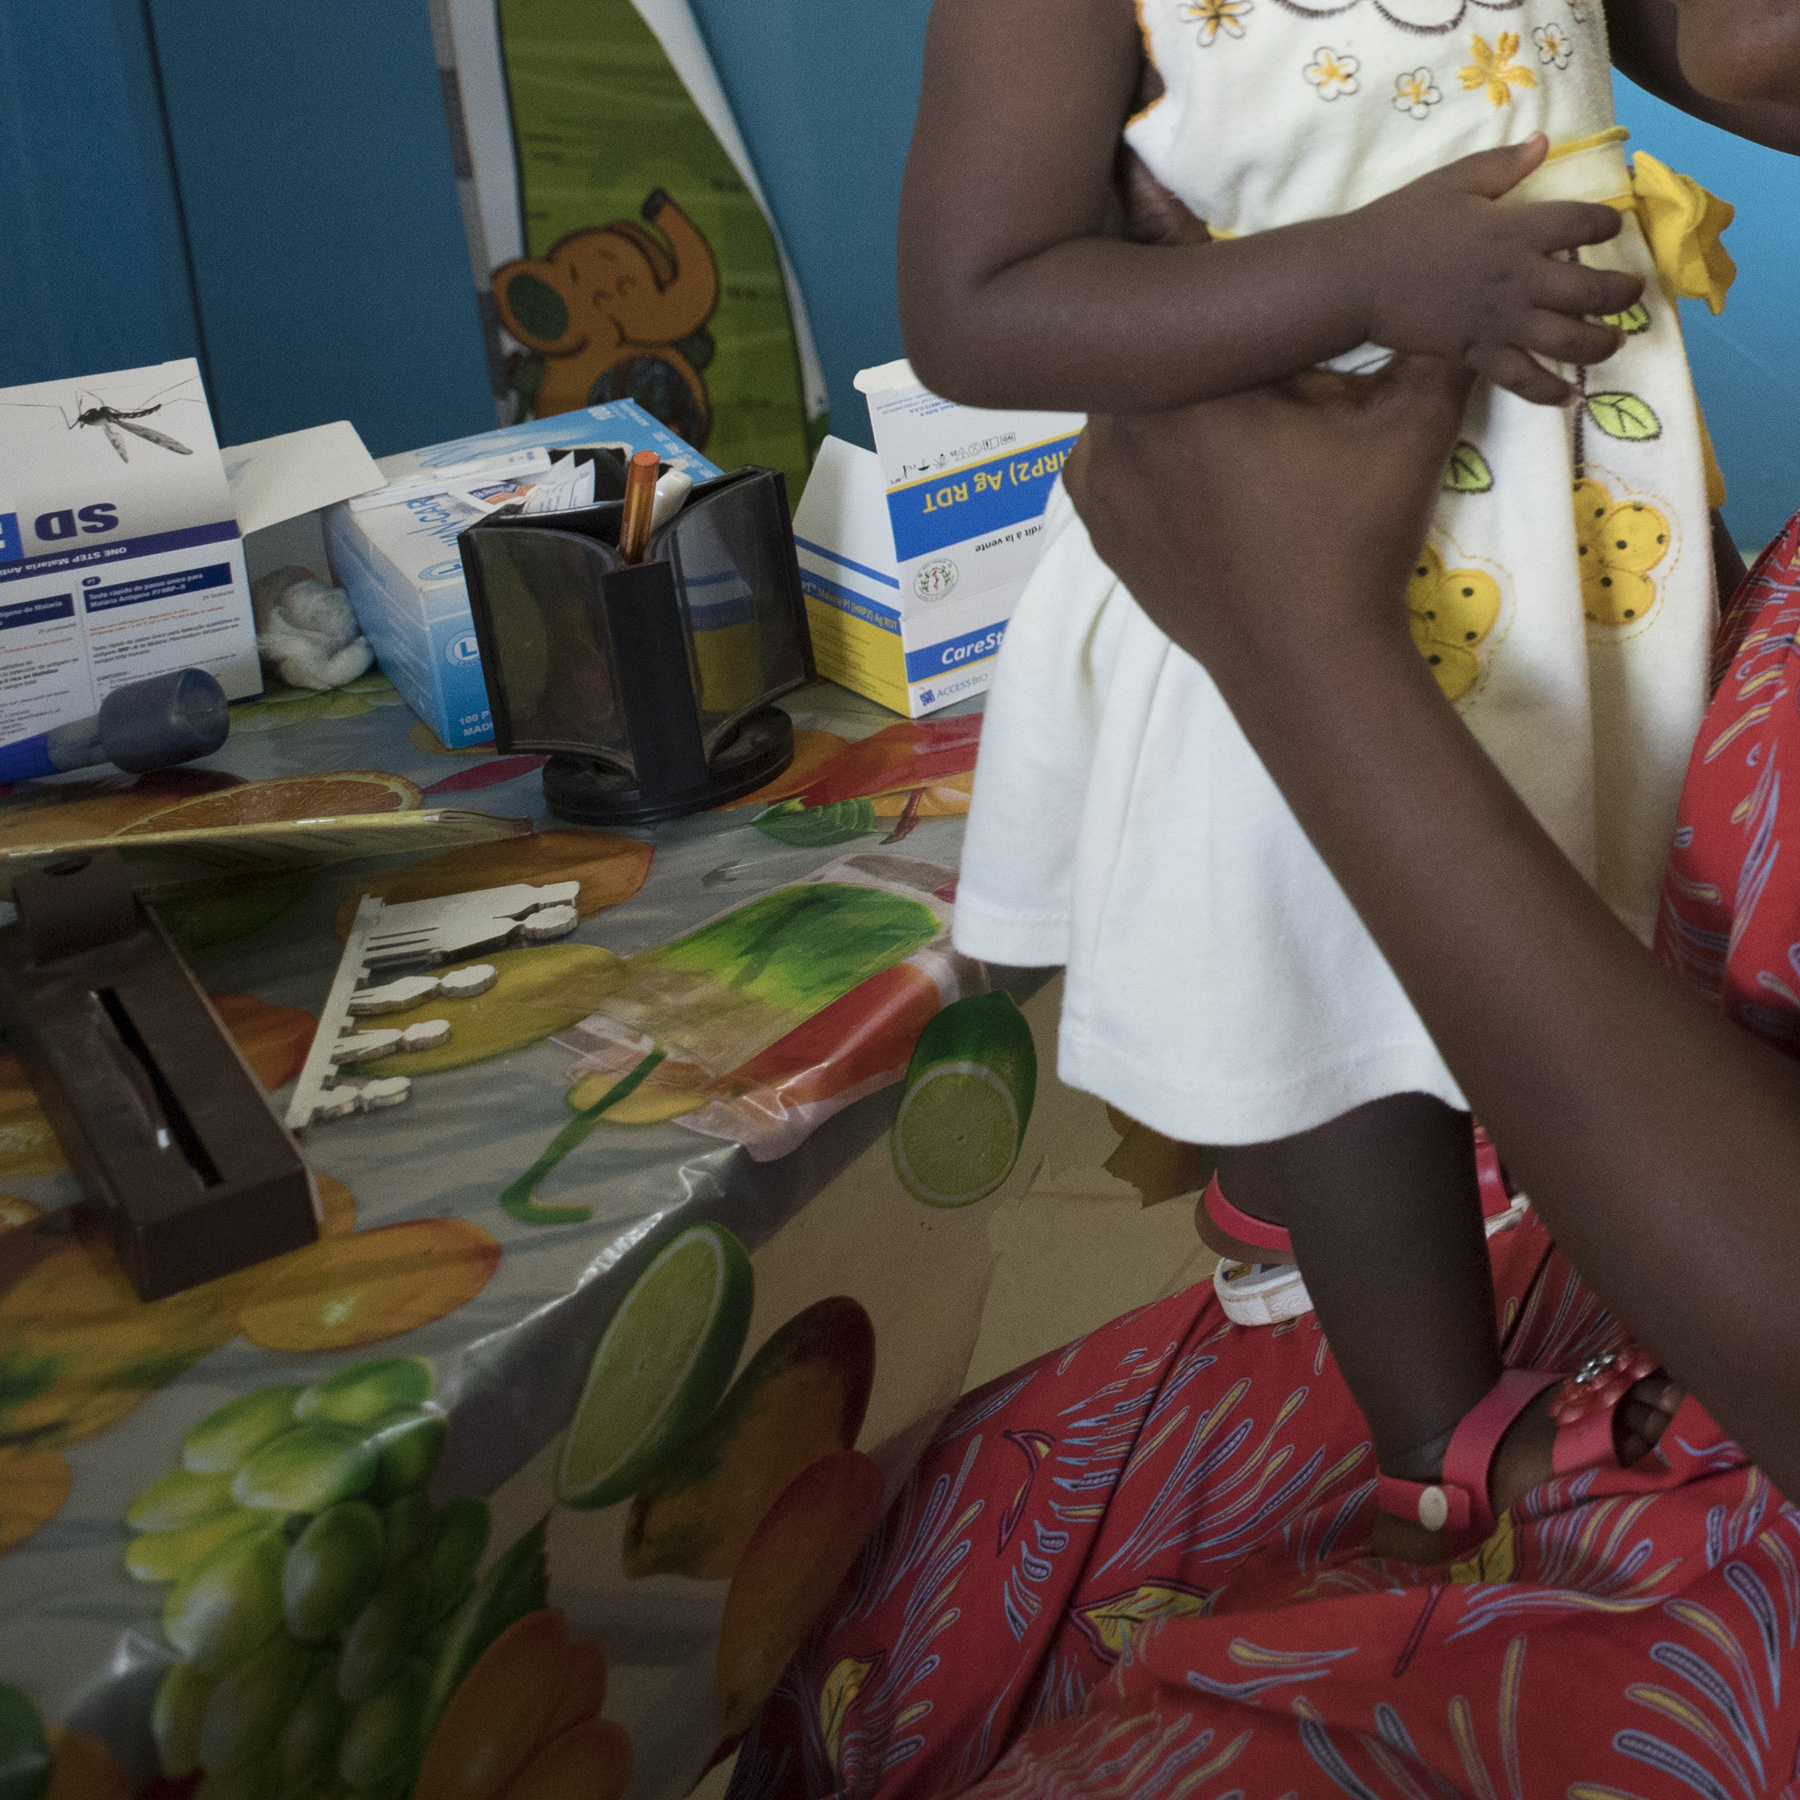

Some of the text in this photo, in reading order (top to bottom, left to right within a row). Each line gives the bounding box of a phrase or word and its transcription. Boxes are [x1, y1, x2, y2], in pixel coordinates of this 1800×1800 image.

[973, 470, 1003, 492] Ag
[923, 482, 969, 514] RDT
[34, 502, 120, 542] SD
[975, 537, 1003, 552] vente
[1005, 533, 1015, 543] la
[26, 546, 127, 571] ONE STEP Malaria
[884, 614, 898, 631] RDT
[936, 672, 988, 699] ACCESS BIO
[457, 711, 479, 726] 100
